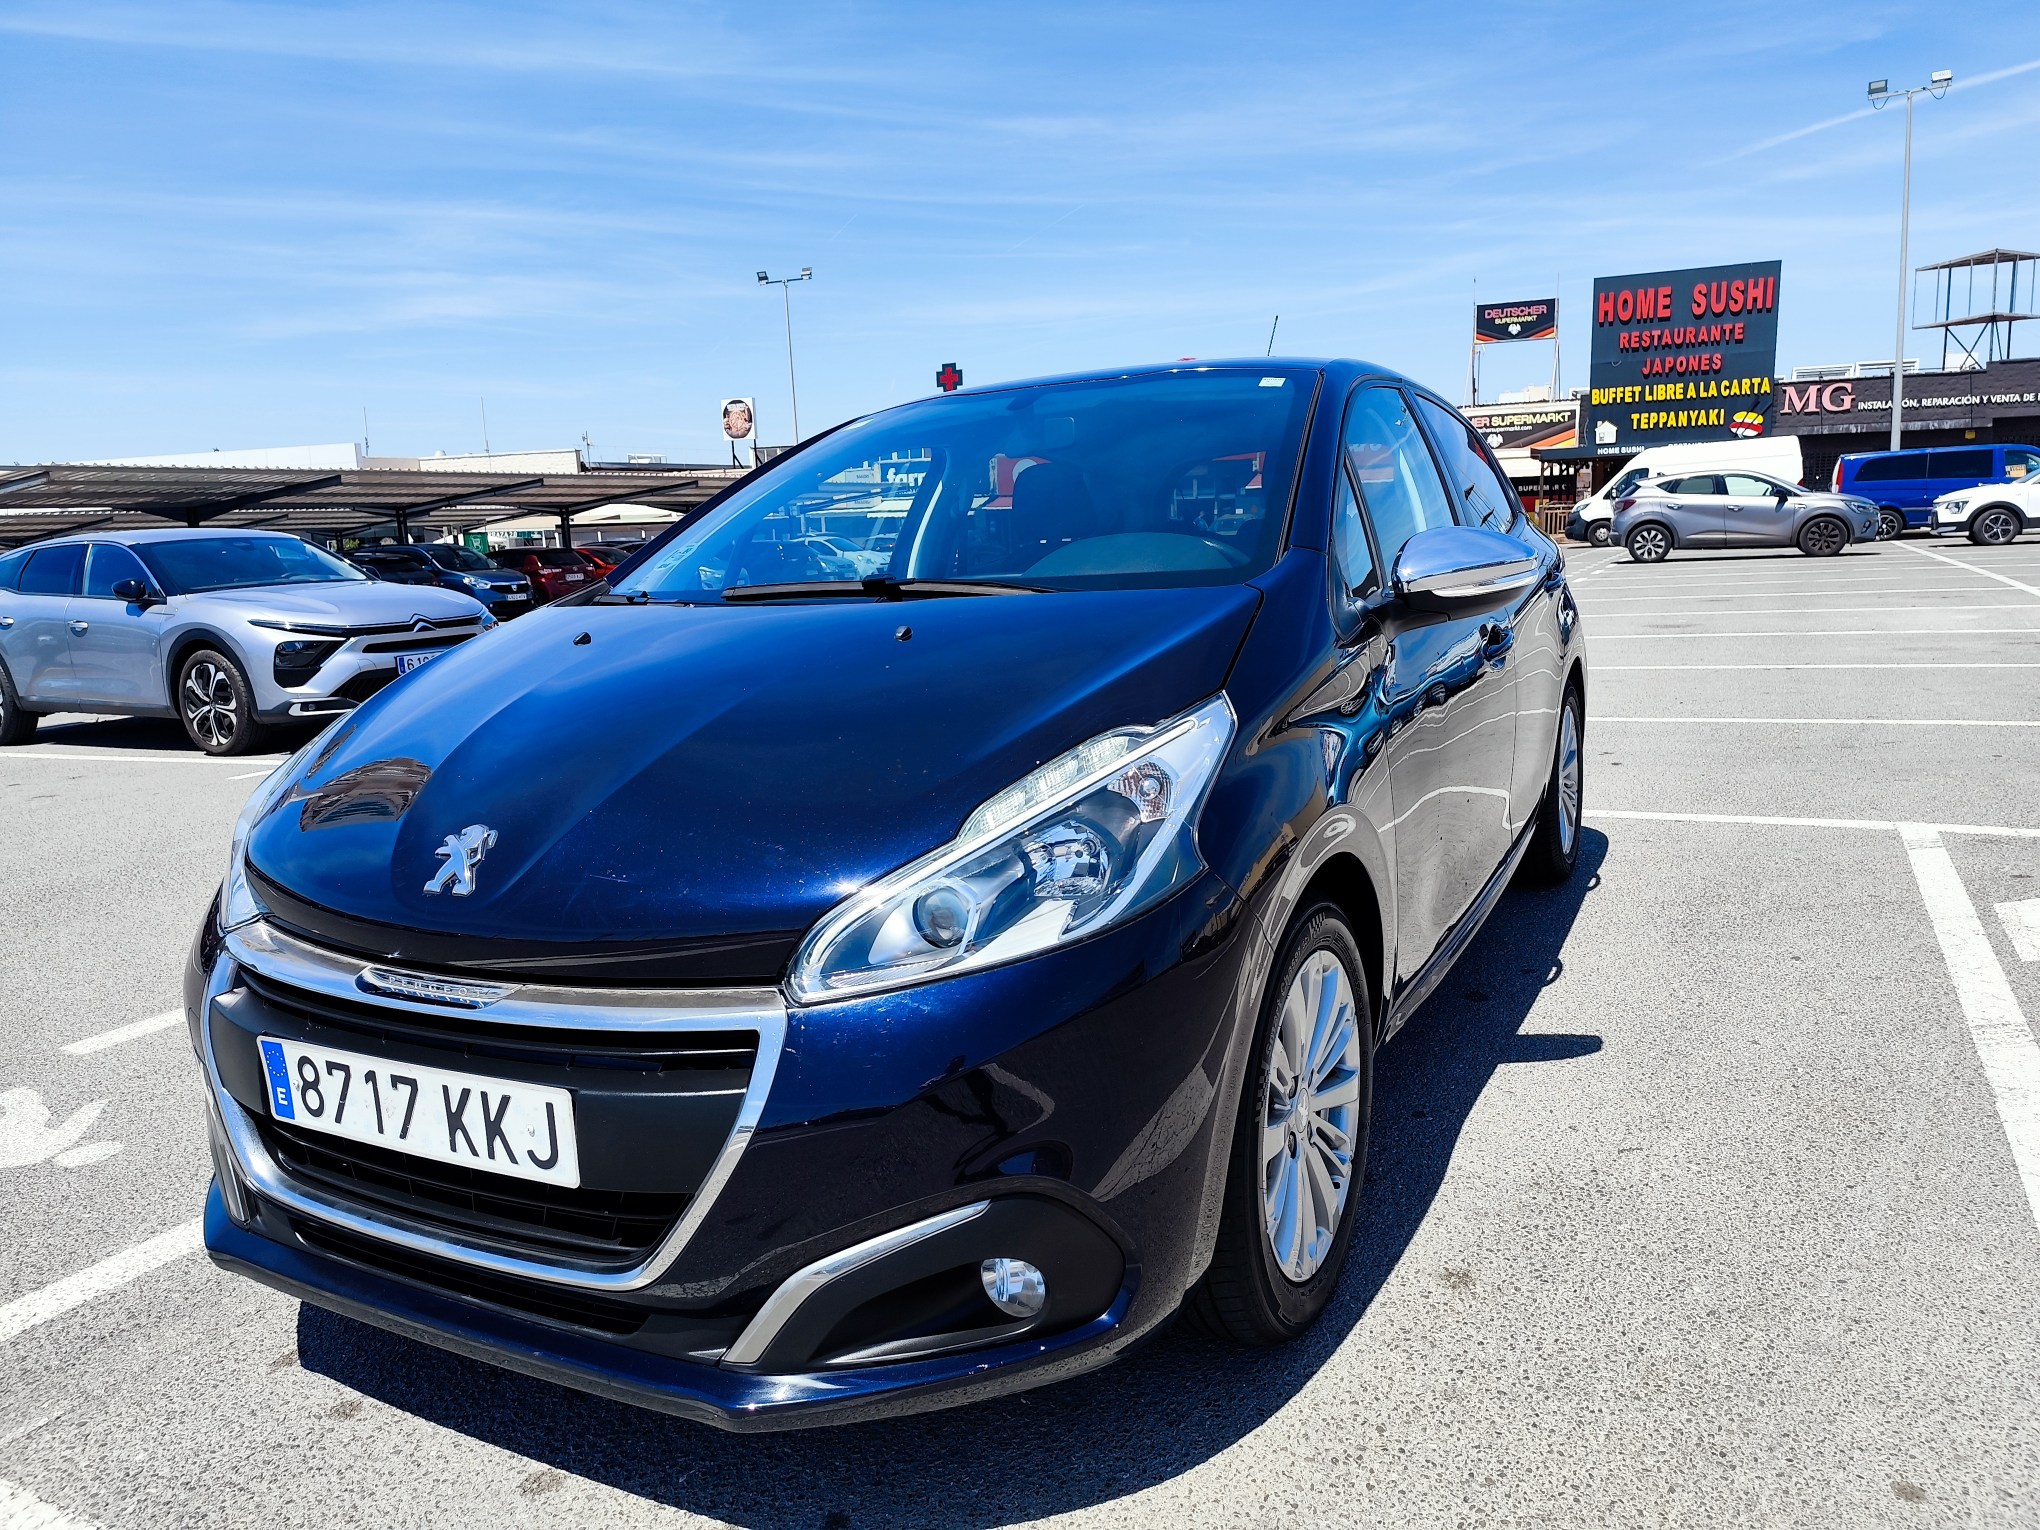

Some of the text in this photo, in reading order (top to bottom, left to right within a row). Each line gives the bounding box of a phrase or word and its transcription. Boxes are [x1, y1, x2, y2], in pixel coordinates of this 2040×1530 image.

[1598, 276, 1775, 323] HOME SUSHI
[1484, 304, 1547, 319] DEUTSCHER
[1494, 314, 1538, 325] SUPERMARKT
[1619, 322, 1744, 349] RESTAURANTE
[1642, 353, 1722, 375] JAPONES
[1591, 377, 1771, 405] BUFFET LIBRE A LA CARTA
[1780, 382, 1856, 414] MG
[1857, 398, 1920, 410] INSTALAÓN,
[1921, 394, 1980, 407] REPARACIÓN
[1982, 395, 1989, 404] Y
[1990, 393, 2021, 403] VENTA
[2023, 393, 2036, 402] DE
[1491, 412, 1571, 427] SUPERMARKT
[1631, 408, 1725, 430] TEPPANYAKI
[1597, 445, 1645, 455] HOME SUSHI
[389, 976, 485, 998] PEUGEOT
[276, 1086, 288, 1106] E
[297, 1055, 559, 1170] 8717 KKJ
